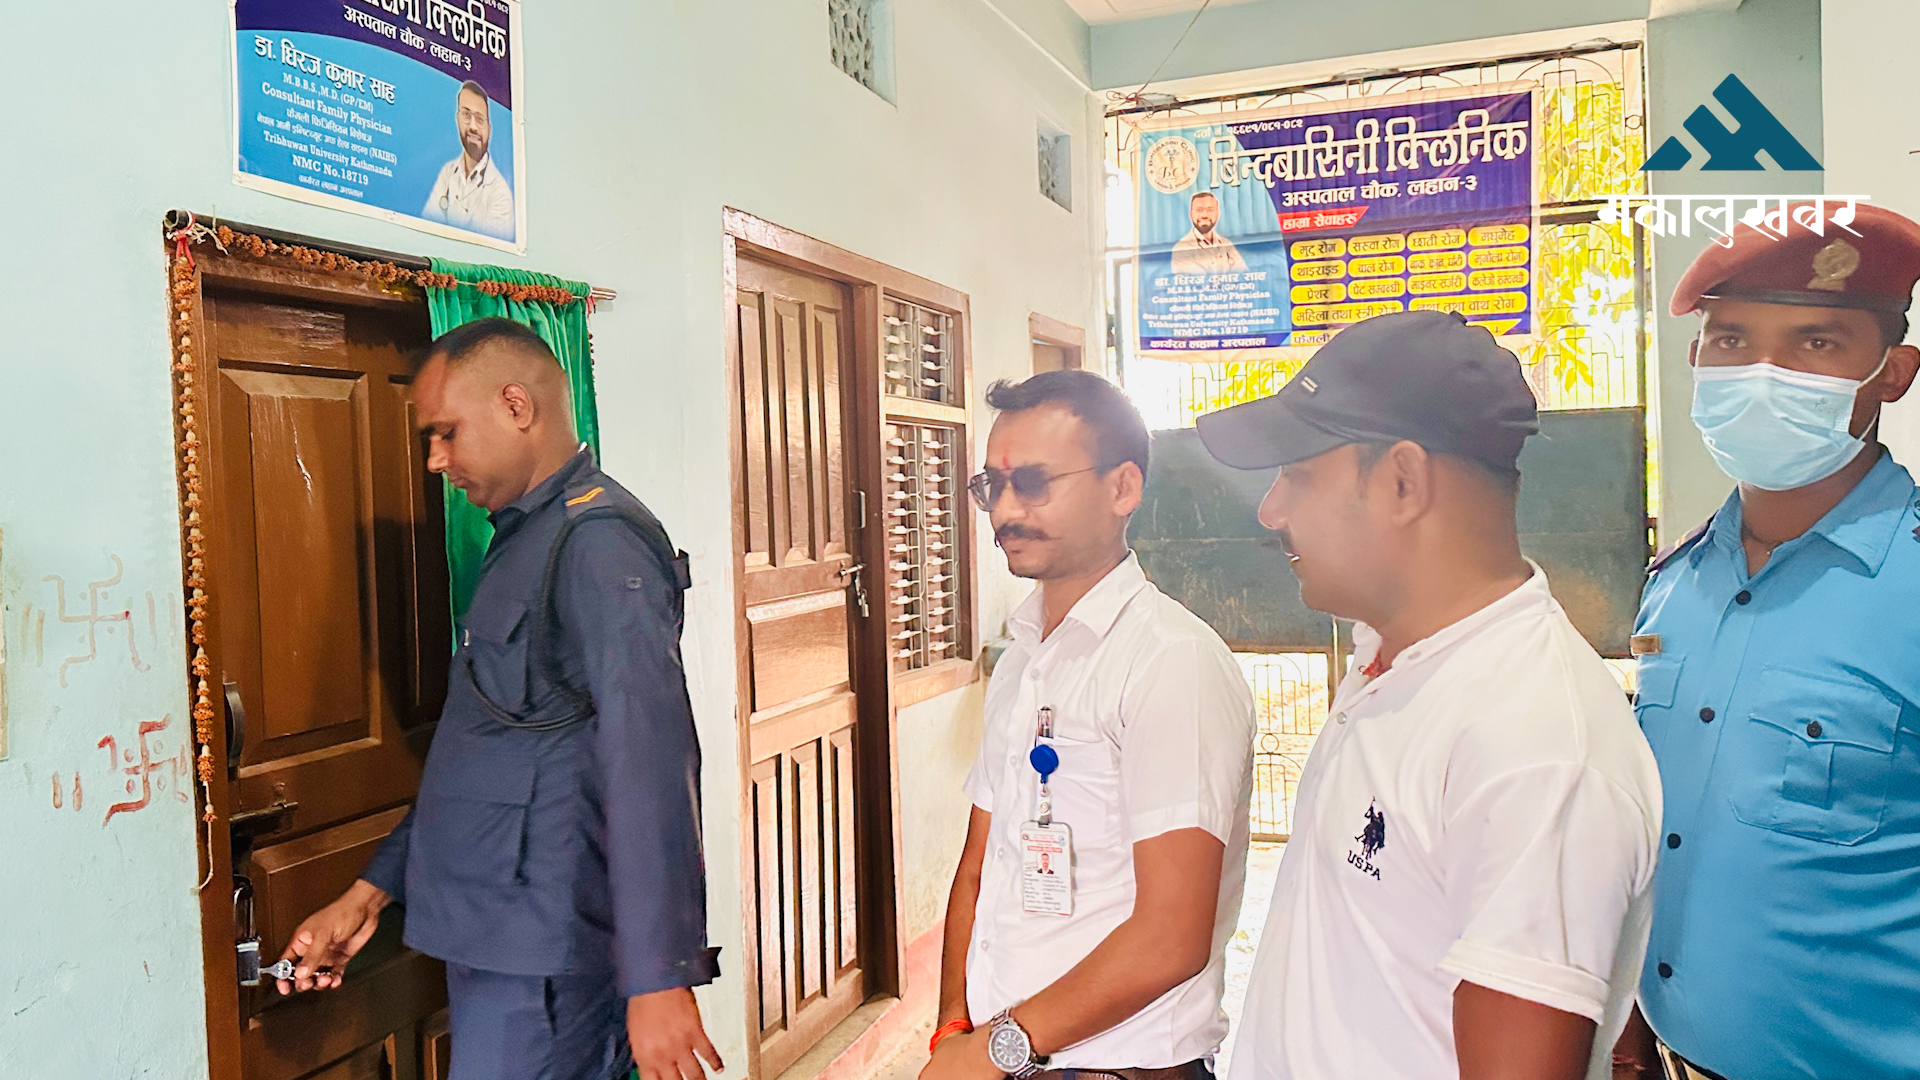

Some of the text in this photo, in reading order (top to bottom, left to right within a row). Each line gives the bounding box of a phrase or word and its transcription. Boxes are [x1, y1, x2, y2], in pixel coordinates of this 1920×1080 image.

[343, 4, 397, 40] अस्पताल
[430, 41, 472, 71] लहान-३
[255, 34, 276, 59] डा.
[325, 61, 366, 92] कुमार
[370, 77, 396, 105] साह
[262, 82, 392, 135] Consultant Family Physician
[341, 93, 374, 114] (GP/EM)
[1385, 108, 1529, 171] क्लिनिक
[263, 130, 393, 178] Tribhuwan University Kathmandu
[292, 154, 321, 172] NMC
[1282, 186, 1355, 207] अस्पताल
[1407, 175, 1477, 196] लहान-३
[1383, 237, 1400, 249] रोग
[1413, 233, 1460, 247] छाती रोग
[1318, 241, 1336, 254] रोग
[1506, 249, 1522, 262] रोग
[1379, 260, 1395, 273] रोग
[1152, 290, 1271, 304] Consultant Family Physician
[1494, 296, 1515, 309] रोग
[1297, 308, 1329, 322] महिला
[1332, 309, 1352, 320] तथा
[1173, 328, 1201, 337] NMC
